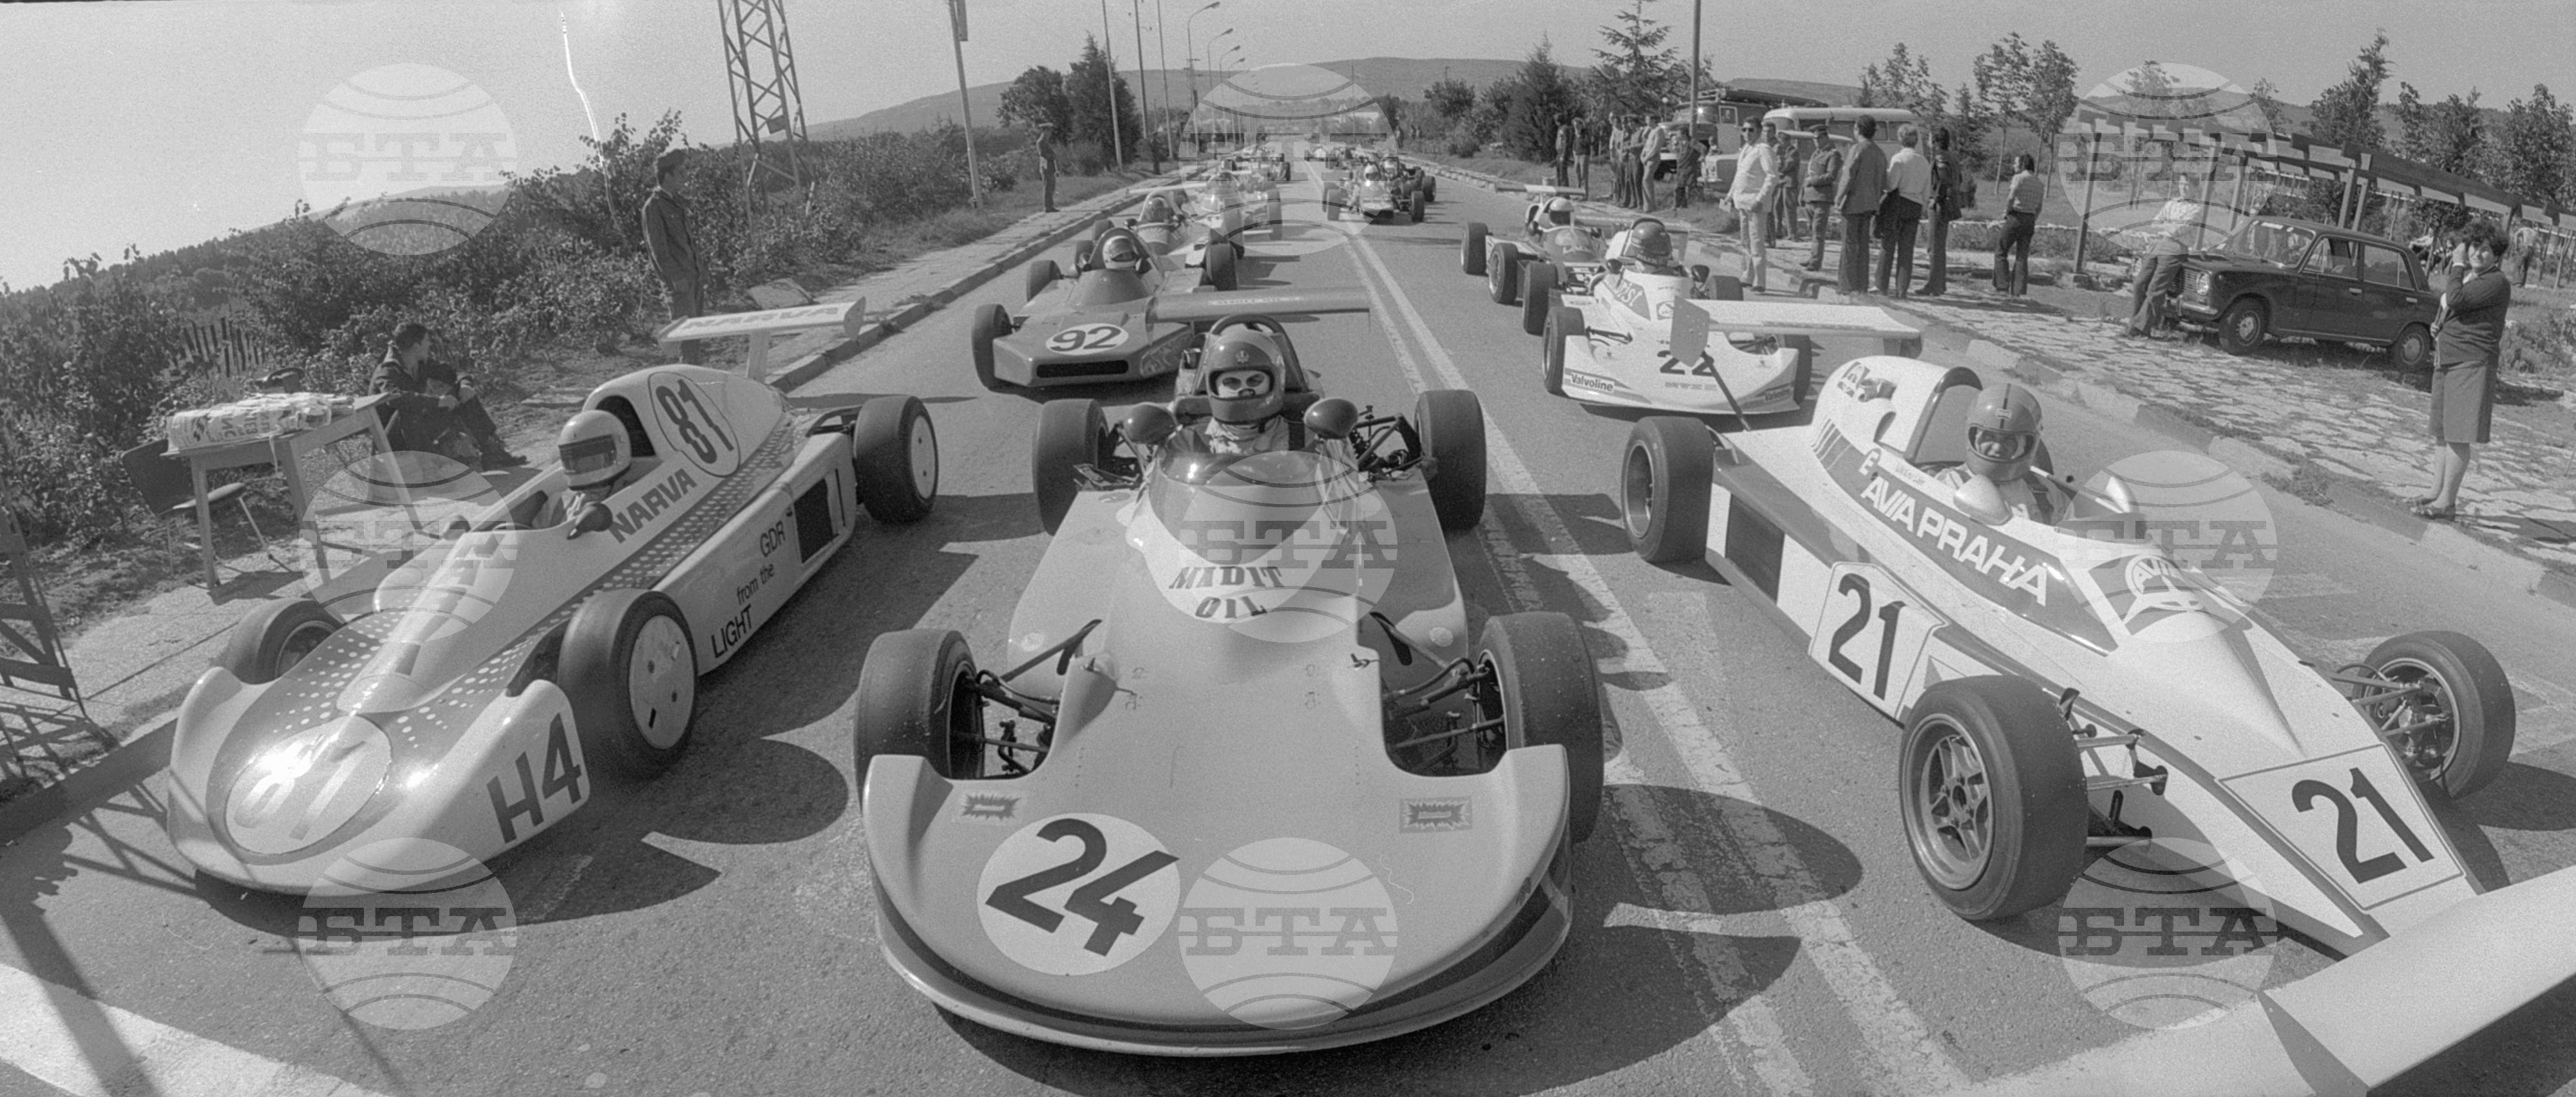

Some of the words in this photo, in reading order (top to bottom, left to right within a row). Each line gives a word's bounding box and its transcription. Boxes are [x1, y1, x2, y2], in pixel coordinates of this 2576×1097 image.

[1050, 326, 1121, 352] 92
[656, 379, 735, 464] 81
[1571, 373, 1614, 392] Valvoline
[609, 468, 697, 544] NARVA
[760, 520, 785, 558] GDR
[1861, 476, 1915, 533] AVIA
[1917, 507, 2047, 606] PRAHA
[737, 577, 759, 605] from
[760, 563, 775, 585] the
[1195, 595, 1268, 619] OIL
[711, 604, 752, 659] LIGHT
[1828, 572, 1906, 701] 21
[234, 736, 369, 841] 81
[486, 713, 582, 844] H4
[2291, 767, 2435, 884] 21
[985, 818, 1180, 957] 24
